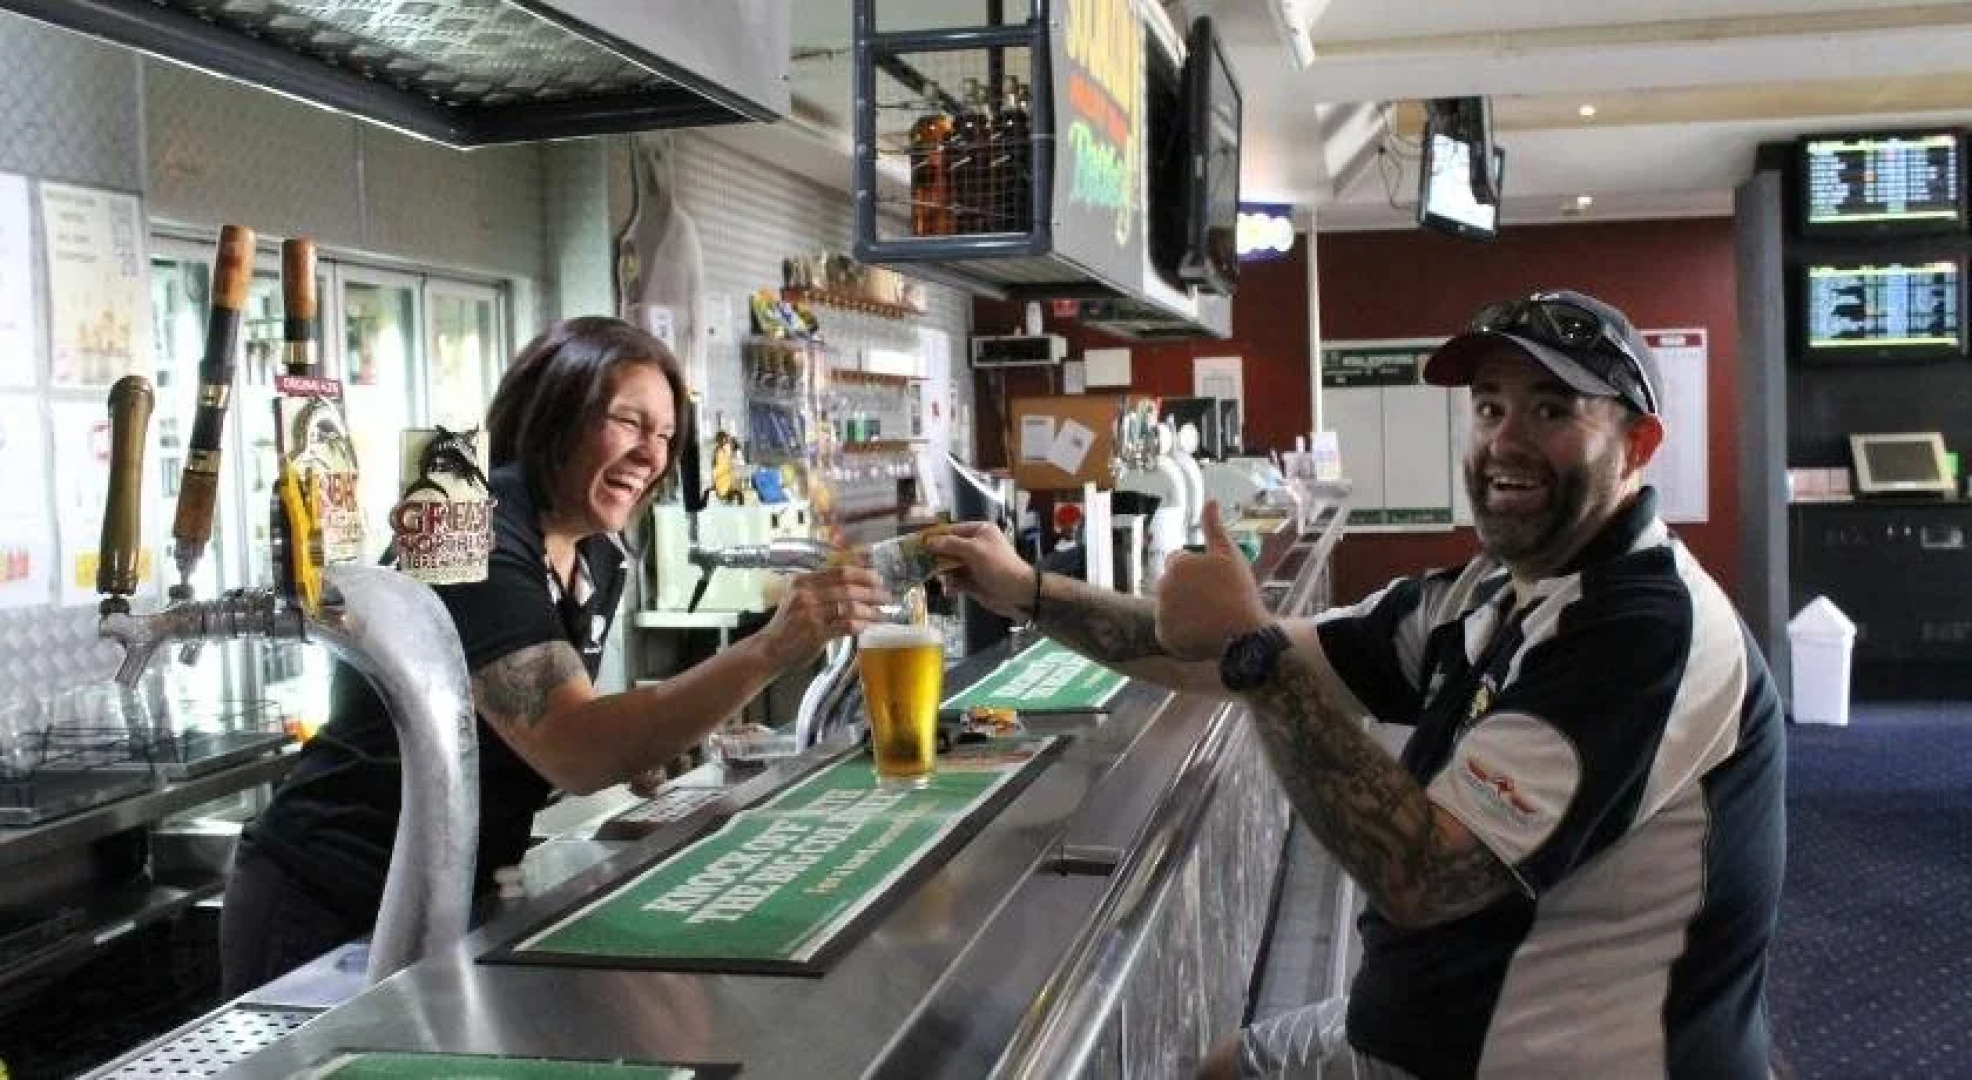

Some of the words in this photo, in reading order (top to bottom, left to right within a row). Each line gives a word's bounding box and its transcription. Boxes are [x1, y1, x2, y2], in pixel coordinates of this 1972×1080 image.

[389, 499, 498, 534] GREAT
[639, 851, 769, 912] KNOCK
[683, 884, 784, 924] THE
